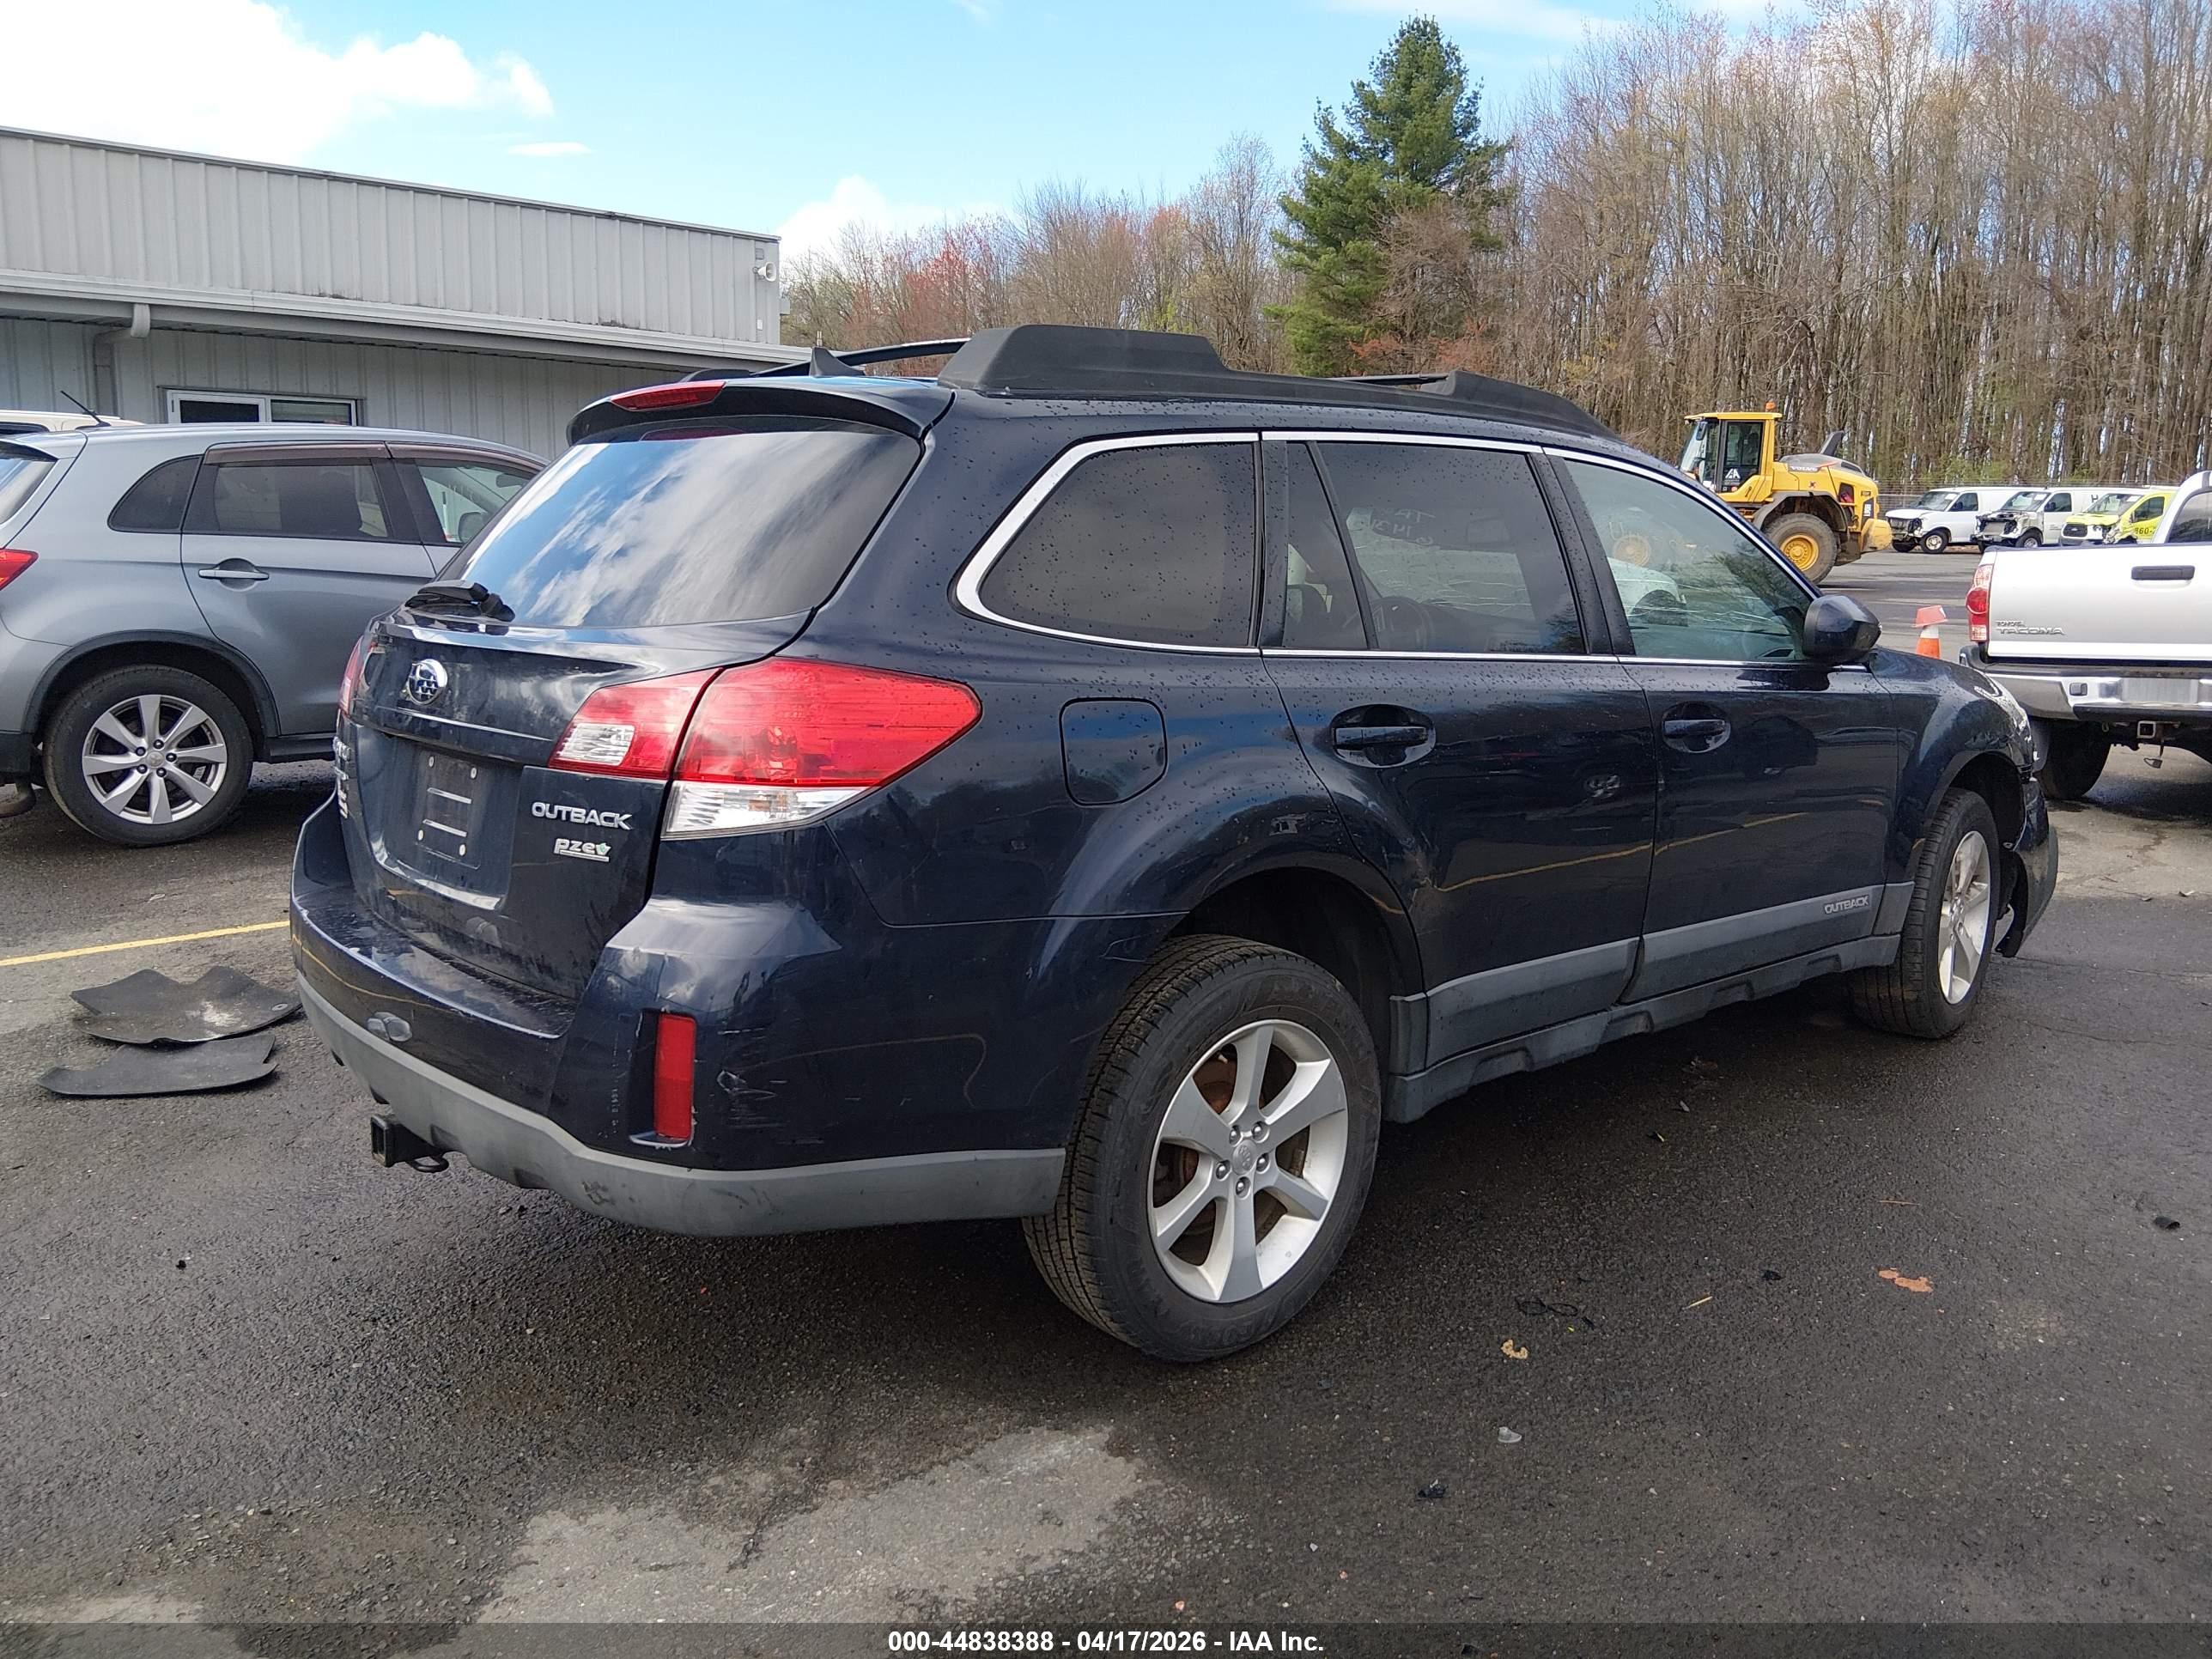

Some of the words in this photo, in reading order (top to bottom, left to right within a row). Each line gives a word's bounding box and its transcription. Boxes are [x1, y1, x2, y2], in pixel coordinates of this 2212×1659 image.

[1996, 627, 2068, 635] TACOMA
[532, 801, 635, 830] OUTBACK
[1824, 895, 1869, 915] OUTBACK
